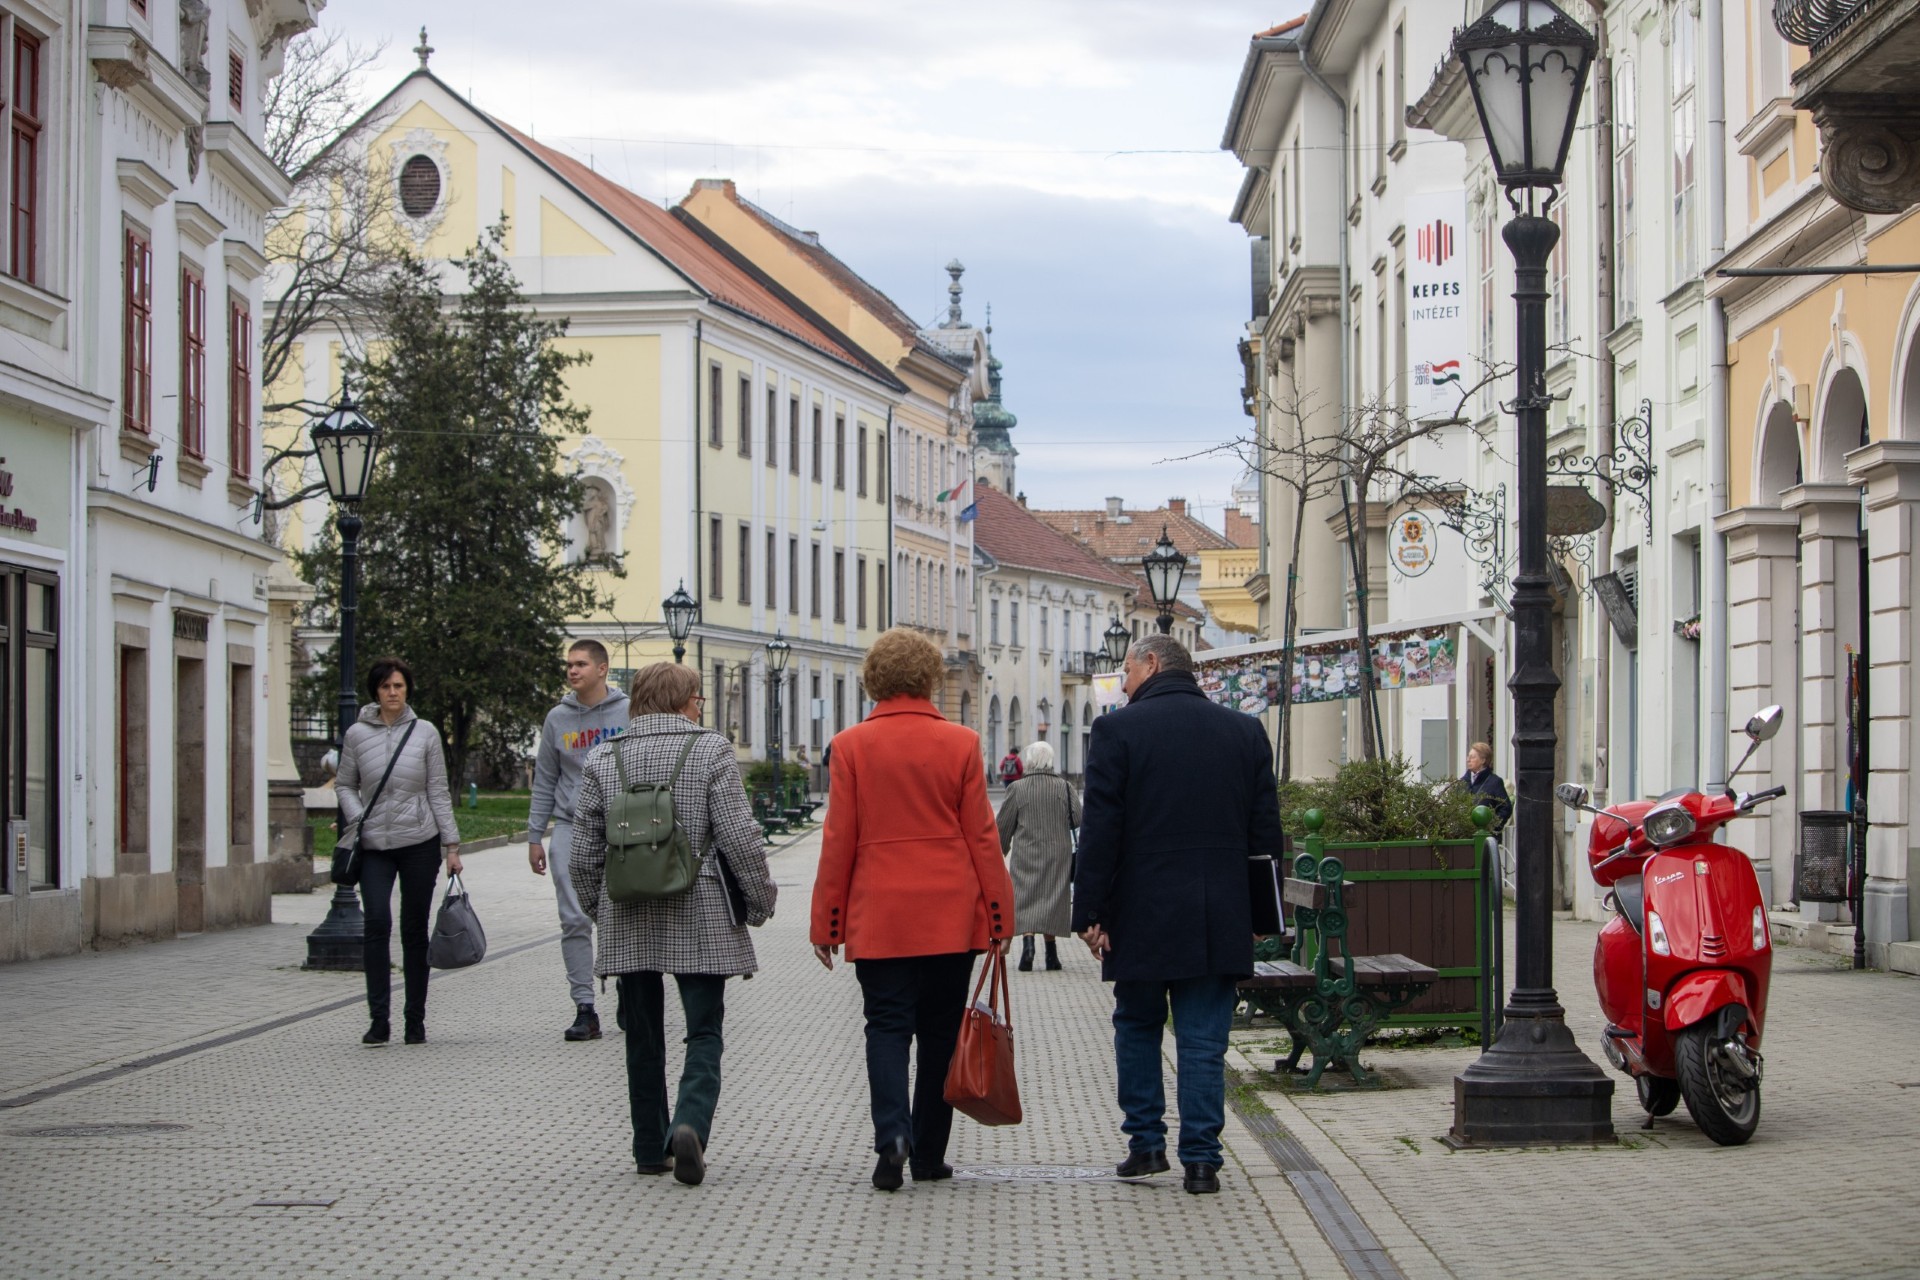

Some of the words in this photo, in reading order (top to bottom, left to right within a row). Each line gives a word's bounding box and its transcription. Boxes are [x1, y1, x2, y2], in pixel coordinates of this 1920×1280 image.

[1412, 282, 1460, 299] KEPES
[1412, 304, 1460, 321] INTÉZET
[1414, 363, 1430, 375] 1956
[1414, 375, 1430, 386] 2016
[1654, 871, 1684, 885] Vespa
